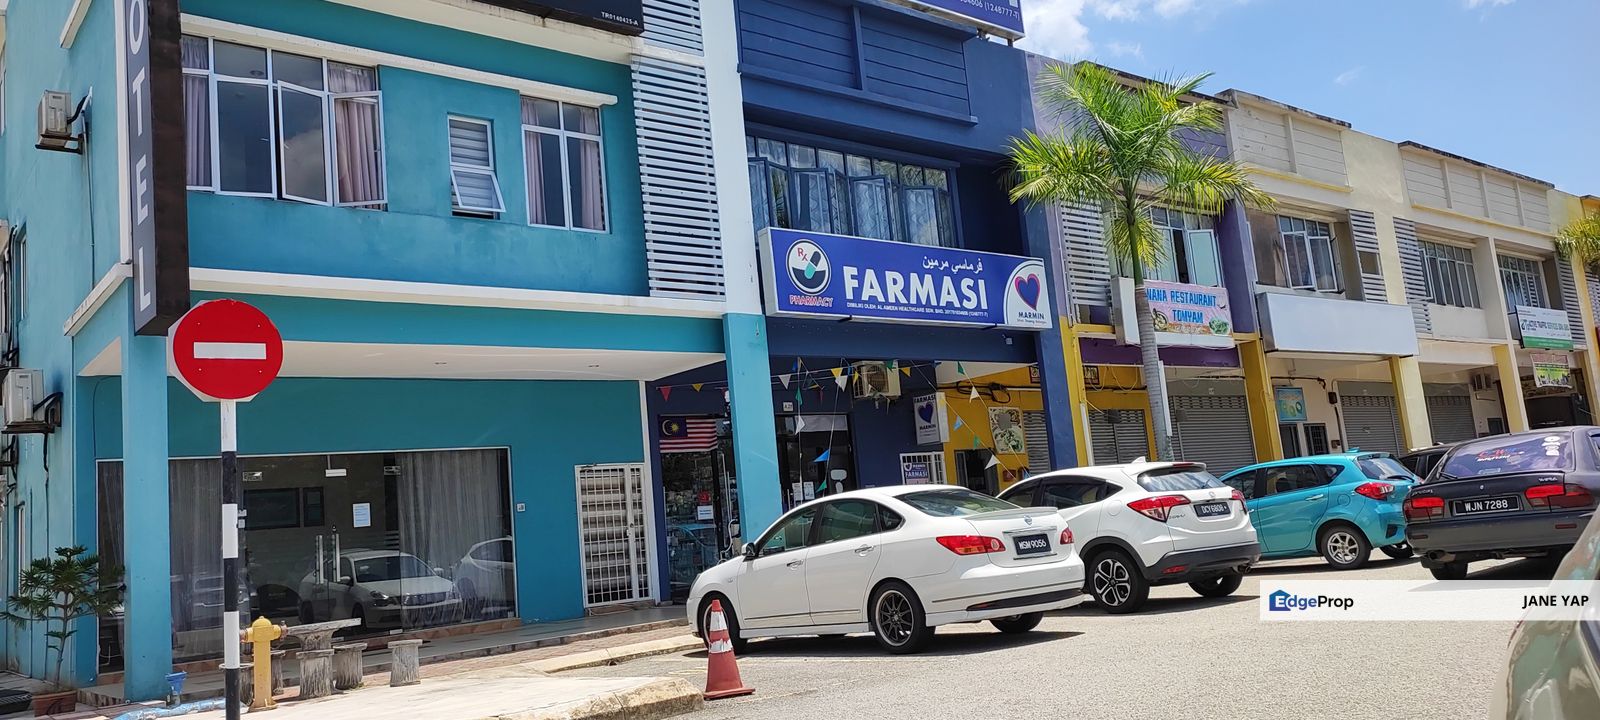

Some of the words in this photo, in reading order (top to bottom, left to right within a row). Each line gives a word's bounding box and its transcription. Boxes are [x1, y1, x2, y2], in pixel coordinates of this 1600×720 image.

[922, 255, 949, 270] مرمين
[951, 258, 983, 274] فرماسي
[842, 265, 989, 310] FARMASI
[789, 294, 834, 308] PHARMACY
[1170, 290, 1217, 307] RESTAURANT
[1018, 311, 1045, 320] MARMIN
[1172, 309, 1204, 323] TOMYAM
[905, 470, 928, 478] FARMASI
[1464, 500, 1483, 512] WJN
[1485, 499, 1509, 510] 7288
[1030, 539, 1047, 549] 9056
